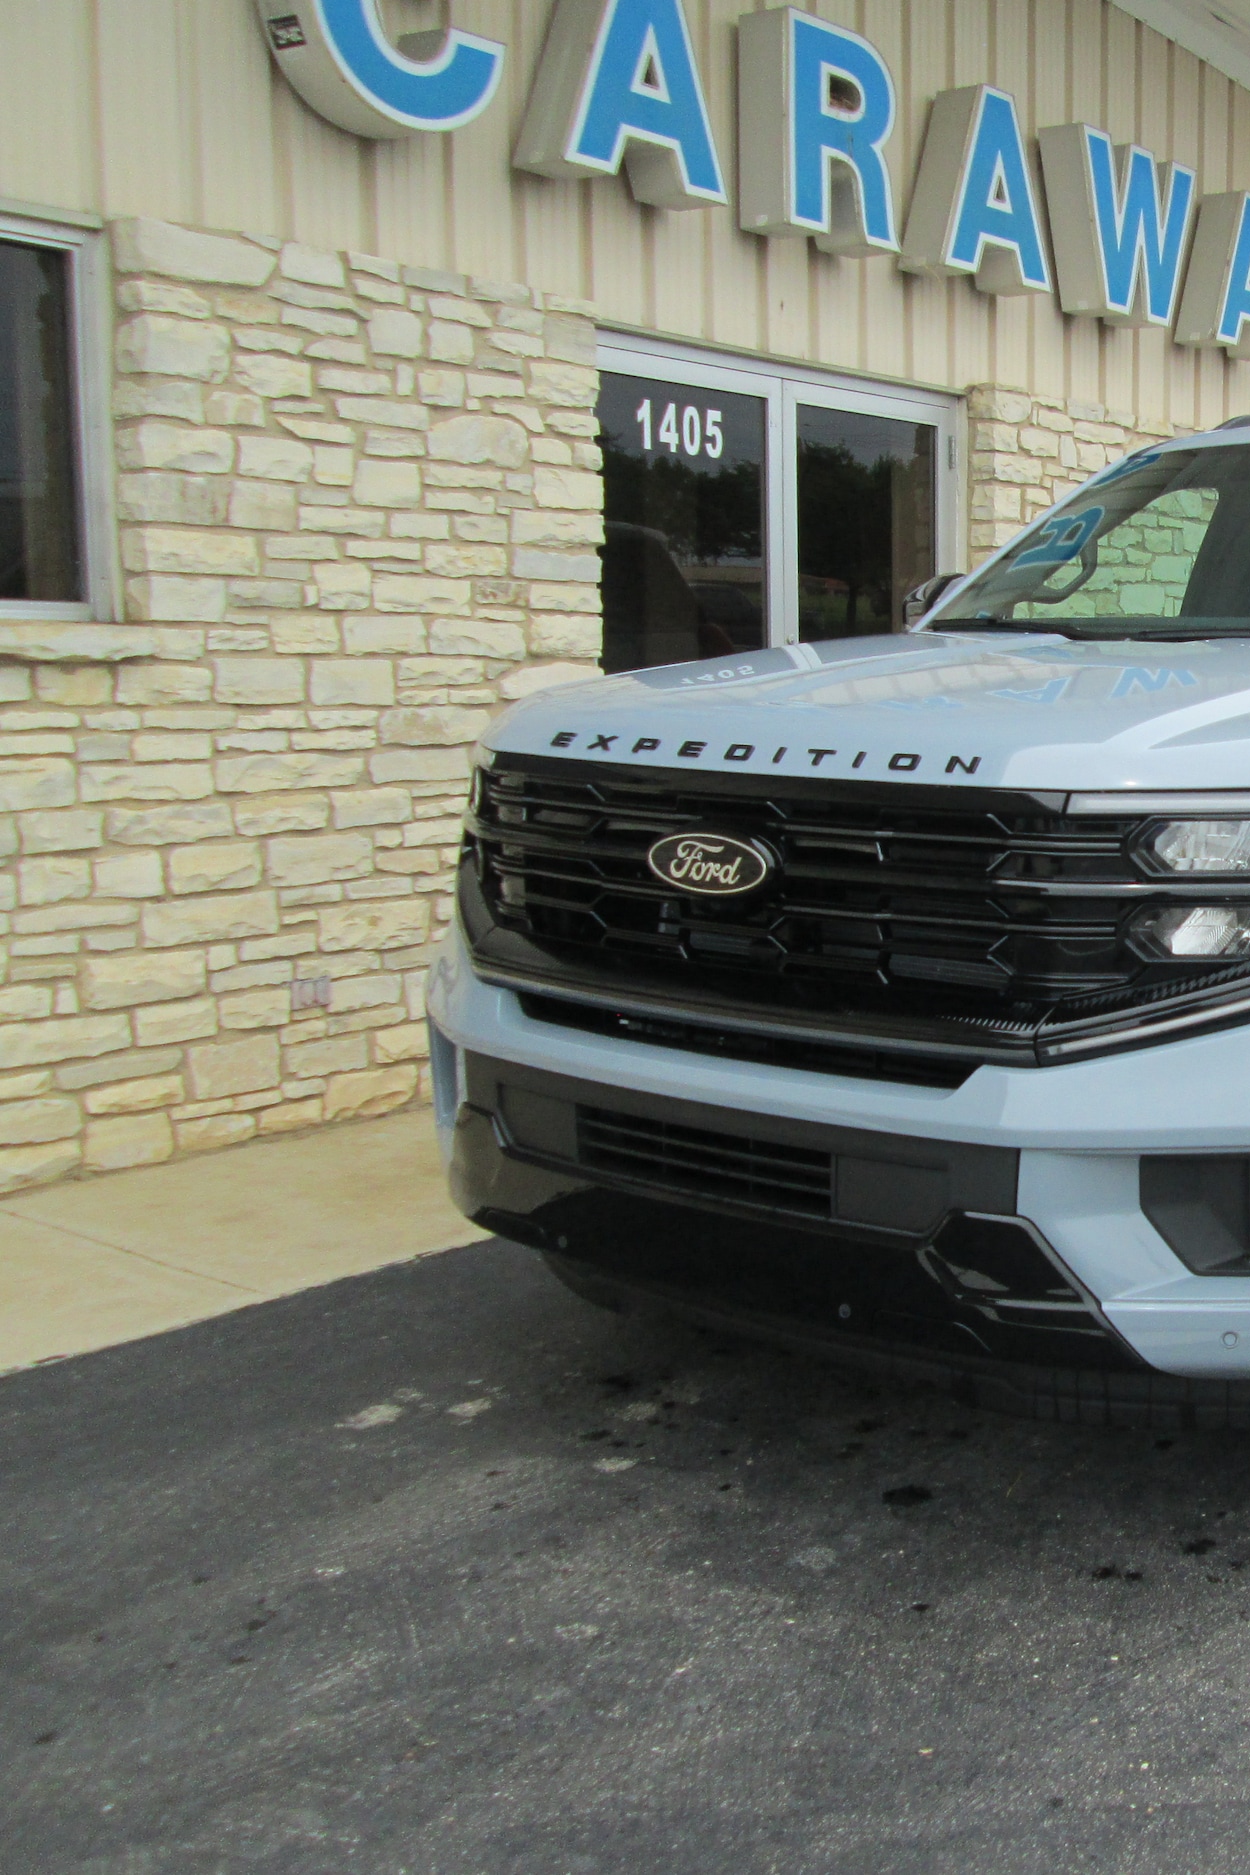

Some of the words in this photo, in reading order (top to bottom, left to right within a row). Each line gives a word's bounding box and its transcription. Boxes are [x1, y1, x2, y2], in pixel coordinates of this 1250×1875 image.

[637, 399, 723, 459] 1405
[550, 731, 982, 774] EXPEDITION
[670, 840, 742, 884] Ford
